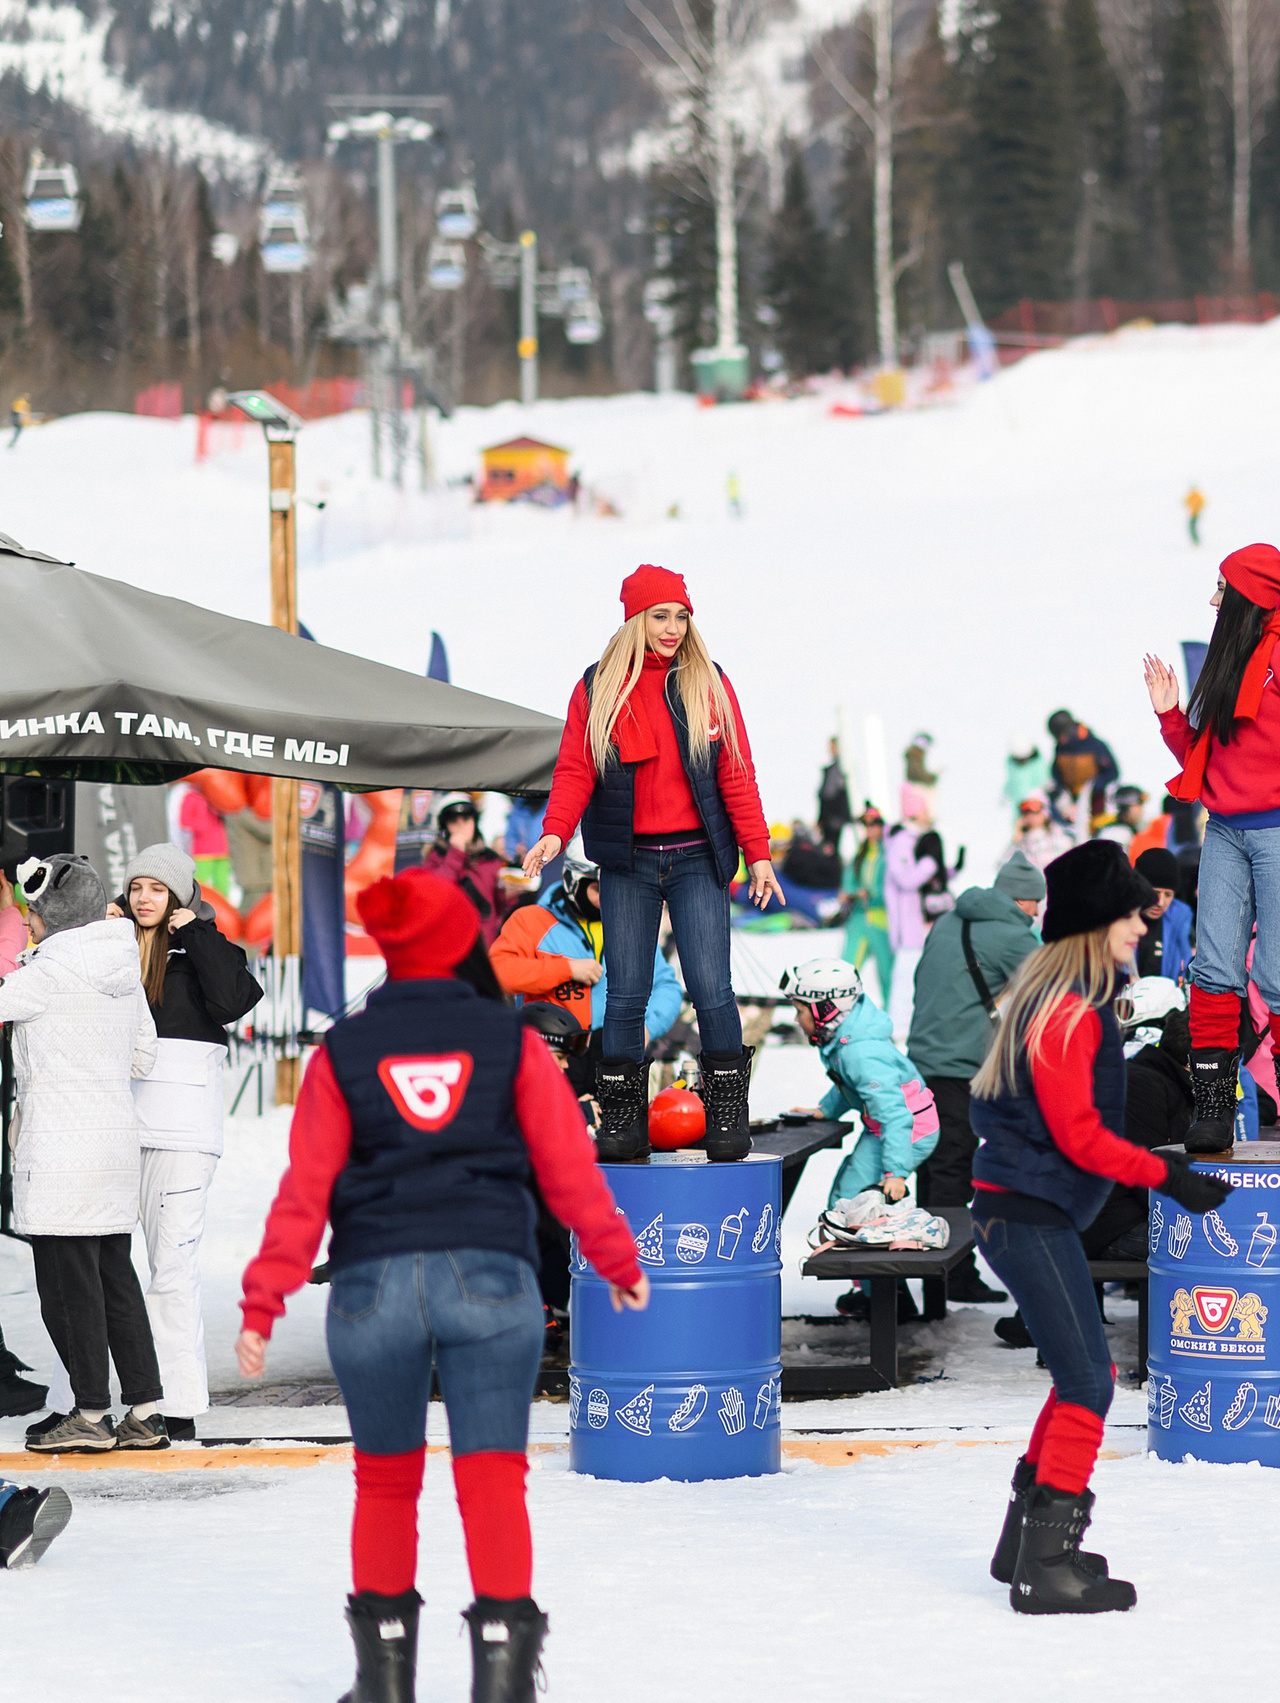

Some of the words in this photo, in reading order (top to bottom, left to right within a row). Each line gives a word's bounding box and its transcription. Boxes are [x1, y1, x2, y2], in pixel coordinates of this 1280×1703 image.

[0, 711, 105, 739] ИНКА
[114, 711, 201, 746] ТАМ,
[206, 728, 275, 758] ГДЕ
[284, 738, 349, 766] МЫ
[1170, 1338, 1217, 1352] ОМСКИЙ
[1220, 1343, 1265, 1353] БЕКОН
